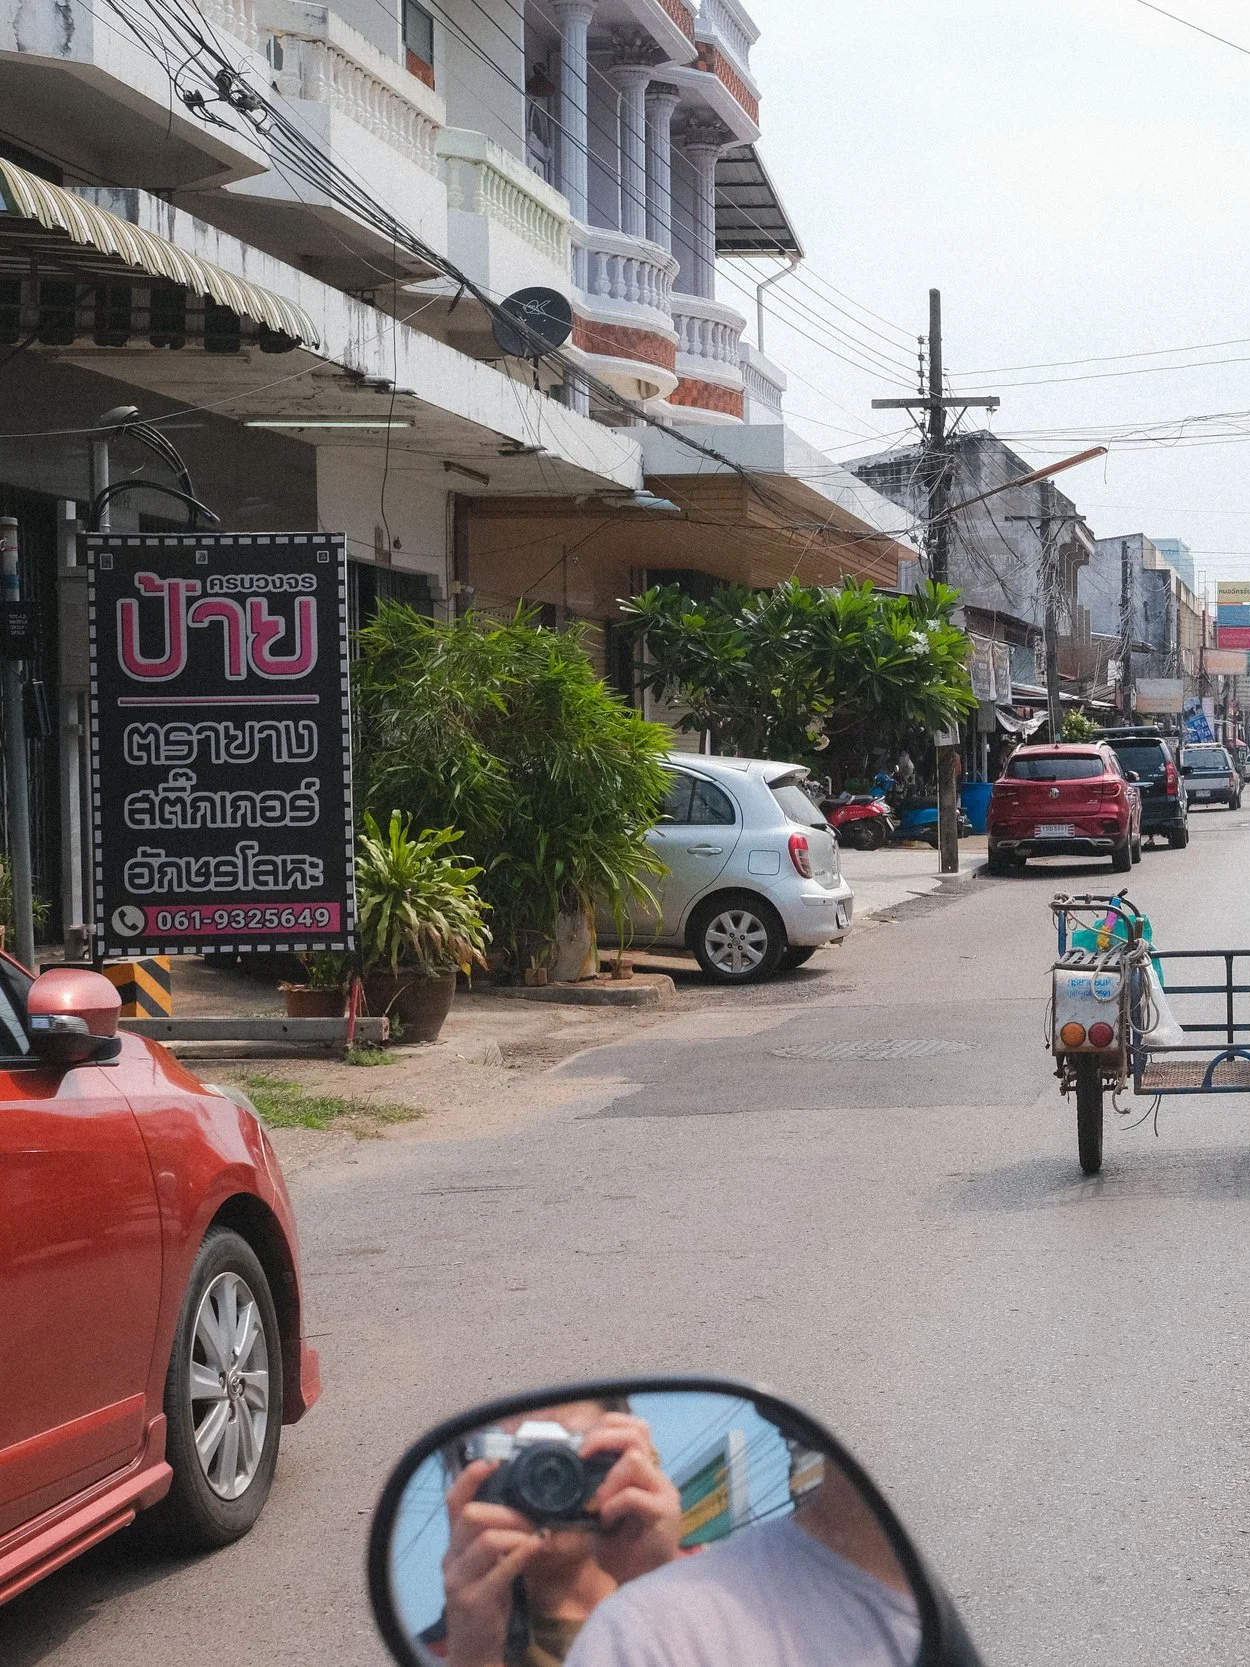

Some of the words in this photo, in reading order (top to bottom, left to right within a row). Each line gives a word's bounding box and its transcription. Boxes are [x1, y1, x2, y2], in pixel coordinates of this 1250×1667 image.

[207, 574, 317, 593] ครบวงจร
[116, 572, 319, 682] ป้าย
[124, 721, 318, 765] ตรายาง
[124, 768, 320, 829] สติ๊กเกอร์
[124, 841, 323, 894] อักษรโลหะ
[156, 907, 331, 932] 061-9325649
